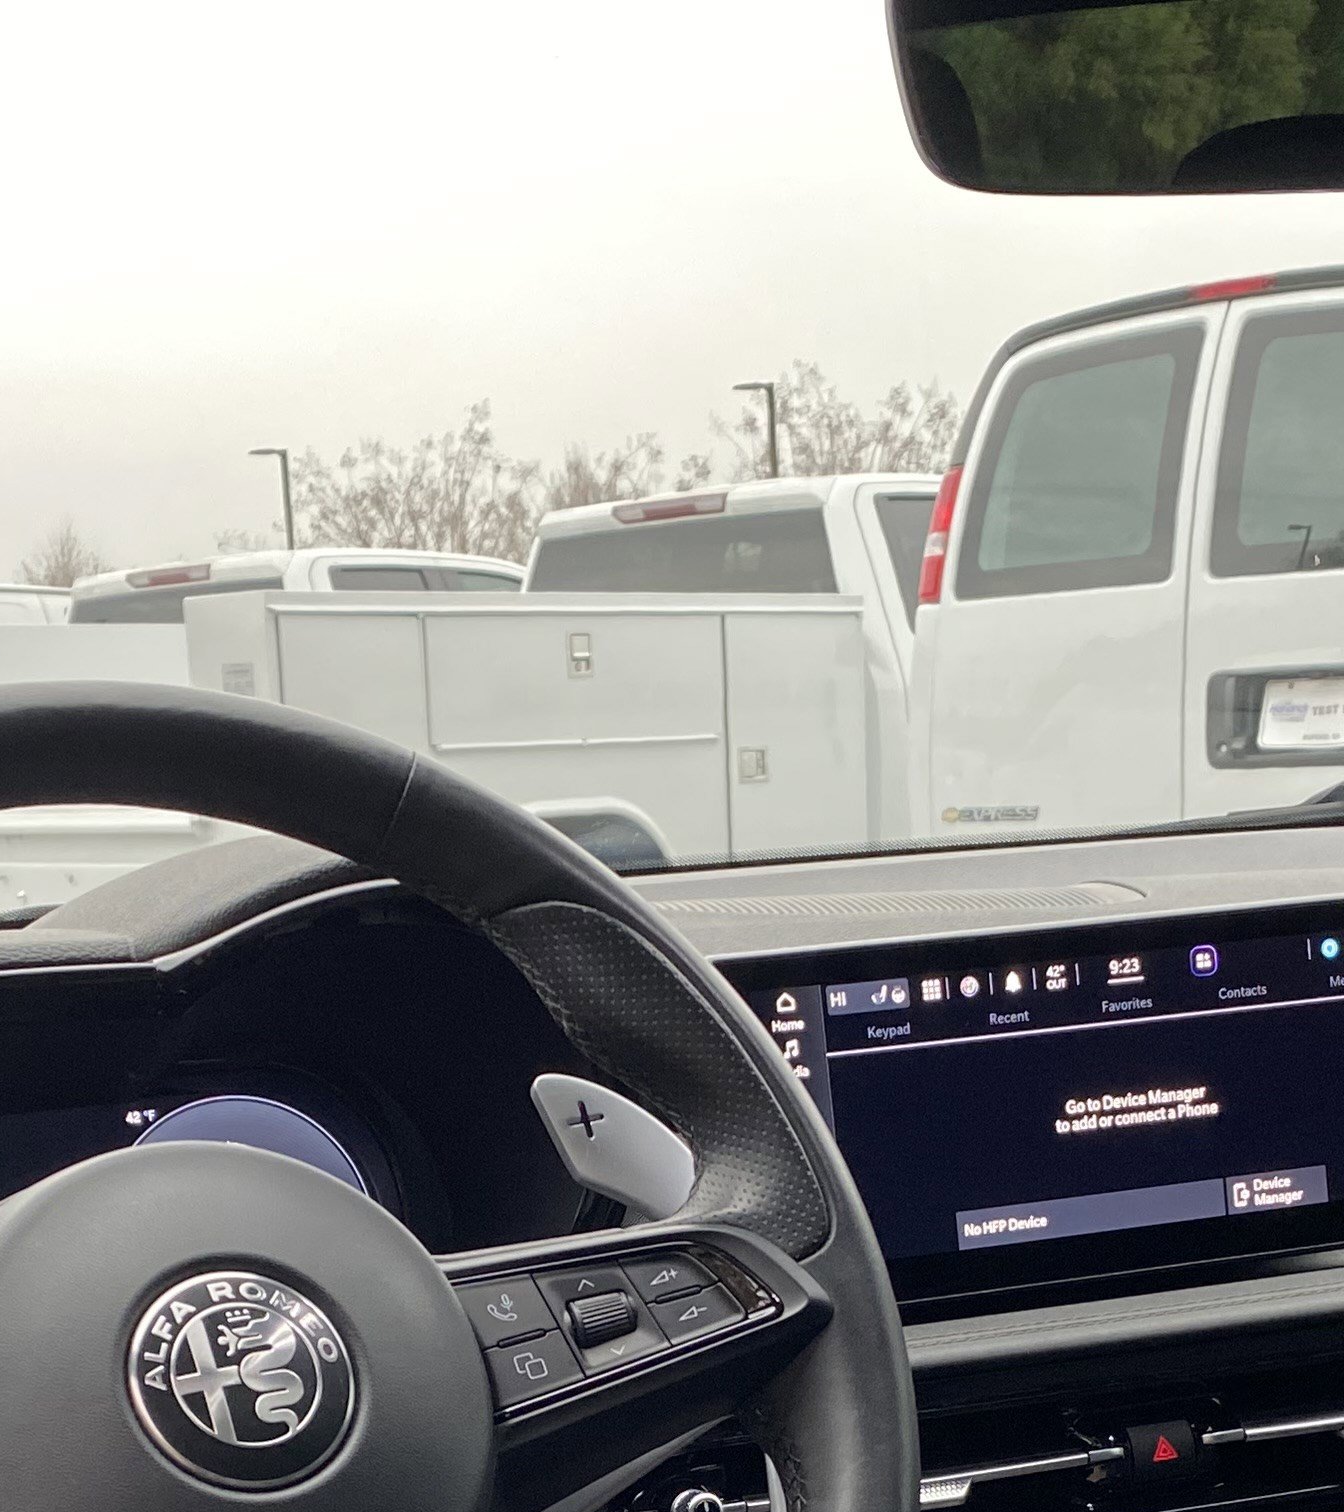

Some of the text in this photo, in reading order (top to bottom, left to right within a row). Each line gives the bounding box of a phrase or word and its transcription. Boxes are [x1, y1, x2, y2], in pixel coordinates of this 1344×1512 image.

[1312, 704, 1339, 716] TEST
[1109, 958, 1141, 975] 9:23
[1046, 978, 1067, 991] OUT
[830, 991, 847, 1007] HI
[867, 1022, 911, 1039] Keypad
[989, 1010, 1030, 1026] Recent
[1102, 997, 1153, 1013] Favorites
[1218, 985, 1267, 1000] Contacts
[771, 1019, 805, 1033] Home
[1065, 1086, 1207, 1115] Go to Device Manager
[1055, 1119, 1071, 1134] to
[1071, 1114, 1098, 1132] add
[1099, 1115, 1115, 1129] or
[1114, 1107, 1167, 1128] connect
[1177, 1102, 1219, 1119] Phone
[1253, 1176, 1291, 1192] Device
[1254, 1188, 1304, 1206] Manager
[964, 1215, 1048, 1238] No HFP Device
[143, 1281, 339, 1391] ALFA ROMEO
